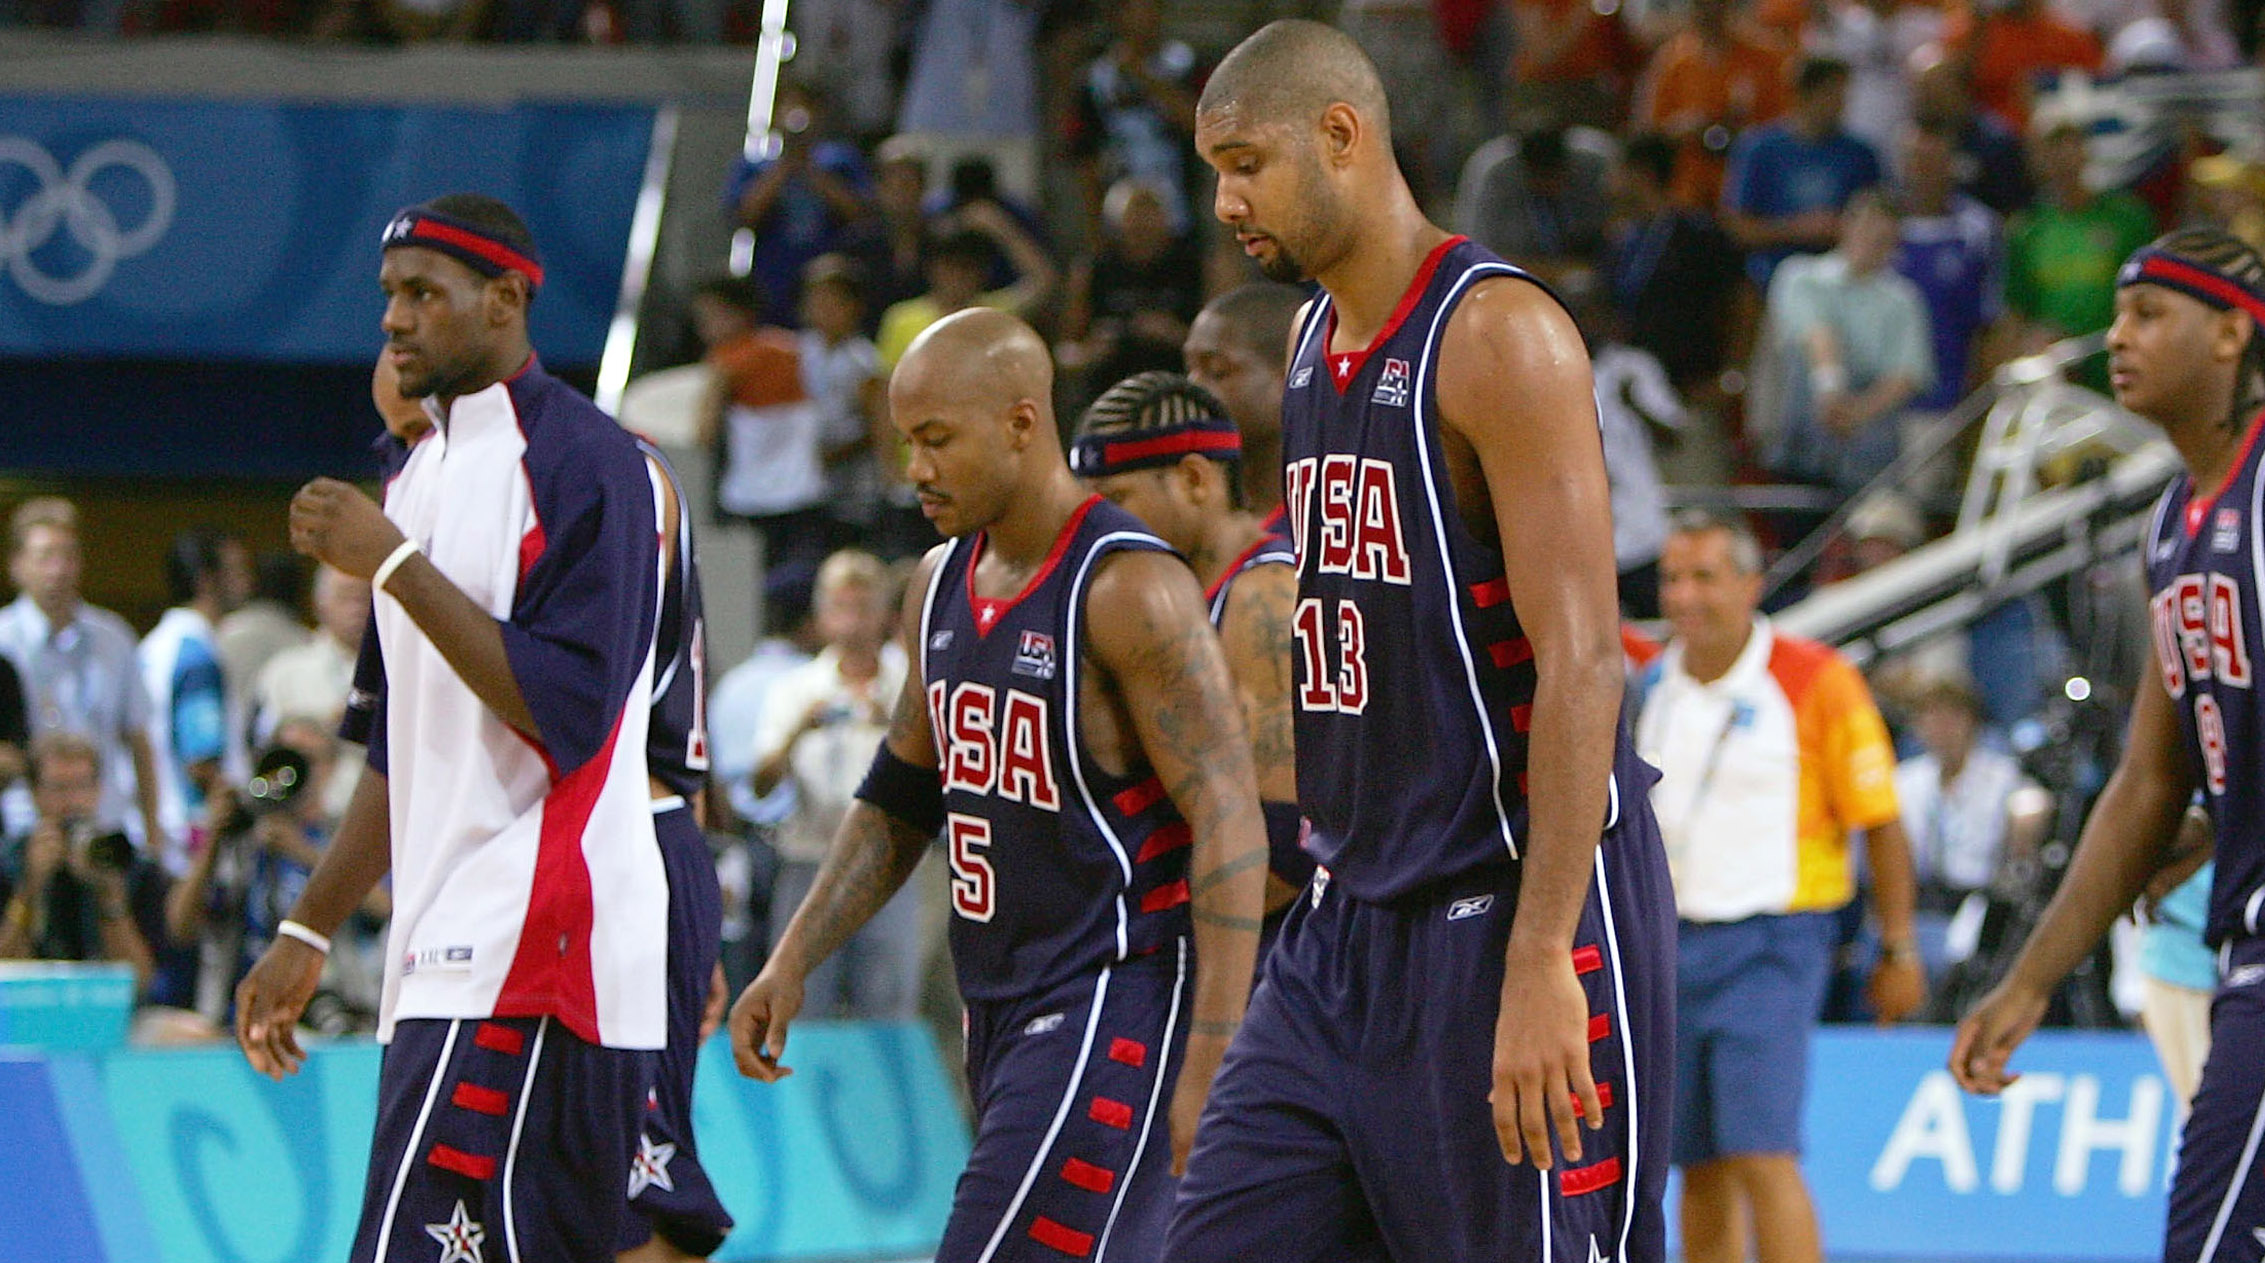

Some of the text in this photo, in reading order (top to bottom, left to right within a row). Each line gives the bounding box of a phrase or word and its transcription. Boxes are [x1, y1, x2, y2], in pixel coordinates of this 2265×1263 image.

[1287, 453, 1412, 585] USA
[1293, 598, 1369, 716] 13
[2150, 571, 2251, 698] USA
[948, 812, 995, 923] 5
[1870, 1070, 2183, 1197] ATH
